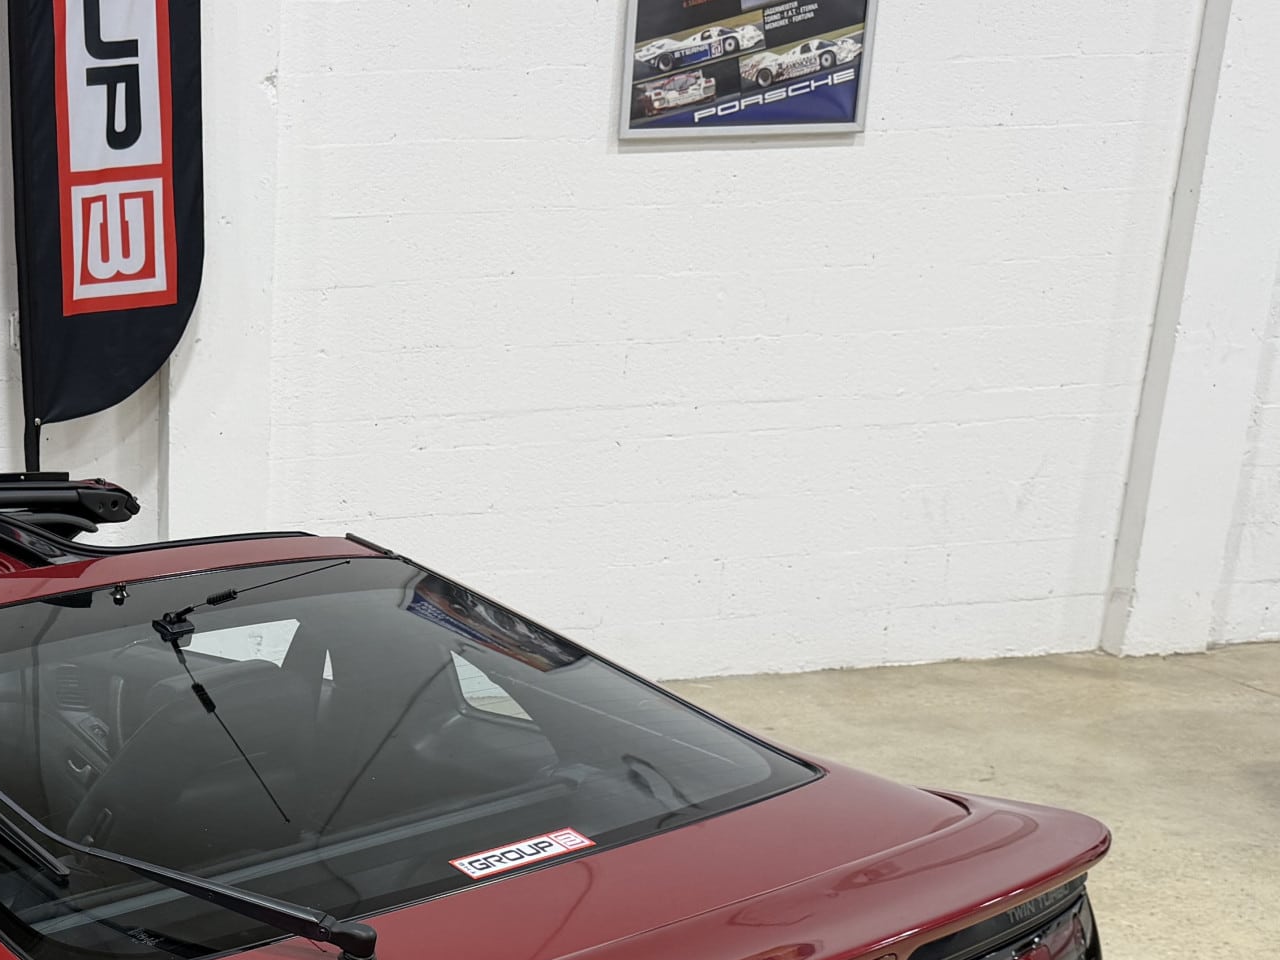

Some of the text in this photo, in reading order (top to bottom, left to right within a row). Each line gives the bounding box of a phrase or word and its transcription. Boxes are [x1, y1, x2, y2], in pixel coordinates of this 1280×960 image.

[693, 68, 855, 123] PORSCHE
[468, 840, 554, 871] GROUP
[1007, 901, 1037, 924] TWIN
